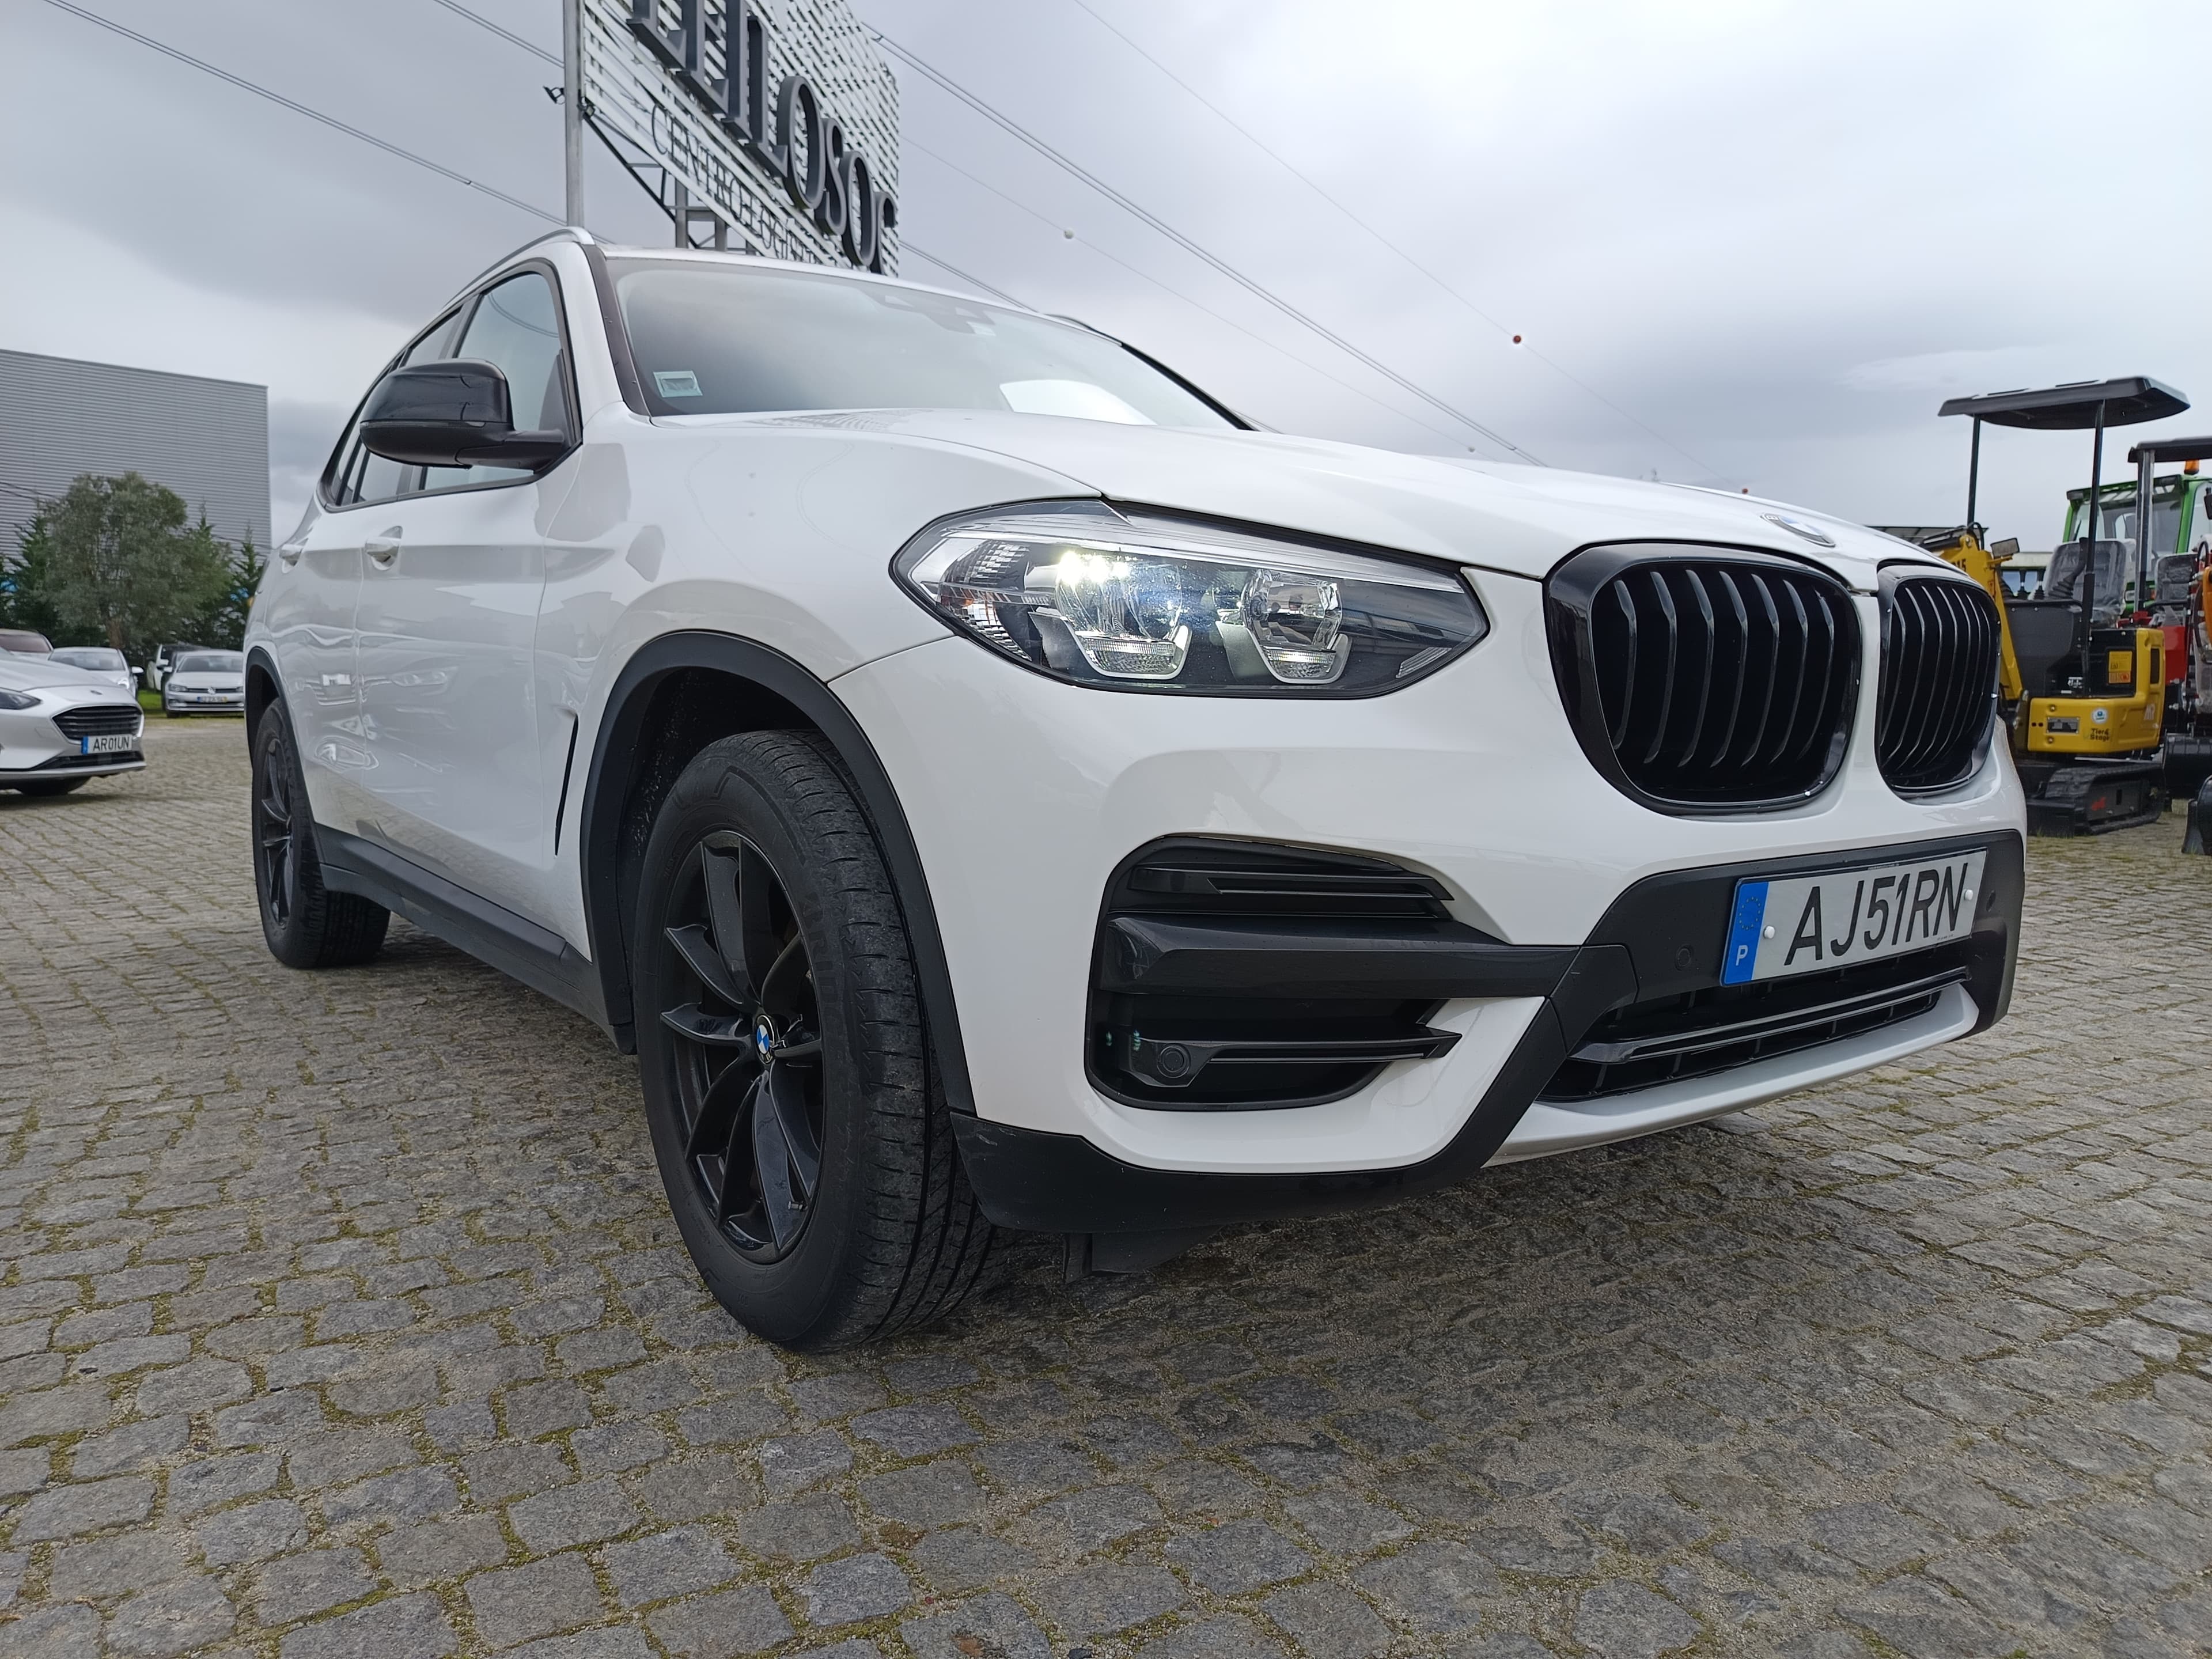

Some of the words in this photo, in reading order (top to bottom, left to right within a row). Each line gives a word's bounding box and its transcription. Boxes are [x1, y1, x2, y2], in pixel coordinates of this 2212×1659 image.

[93, 736, 130, 751] AR01UN
[1735, 945, 1748, 966] P
[1783, 862, 1968, 966] AJ51RN
